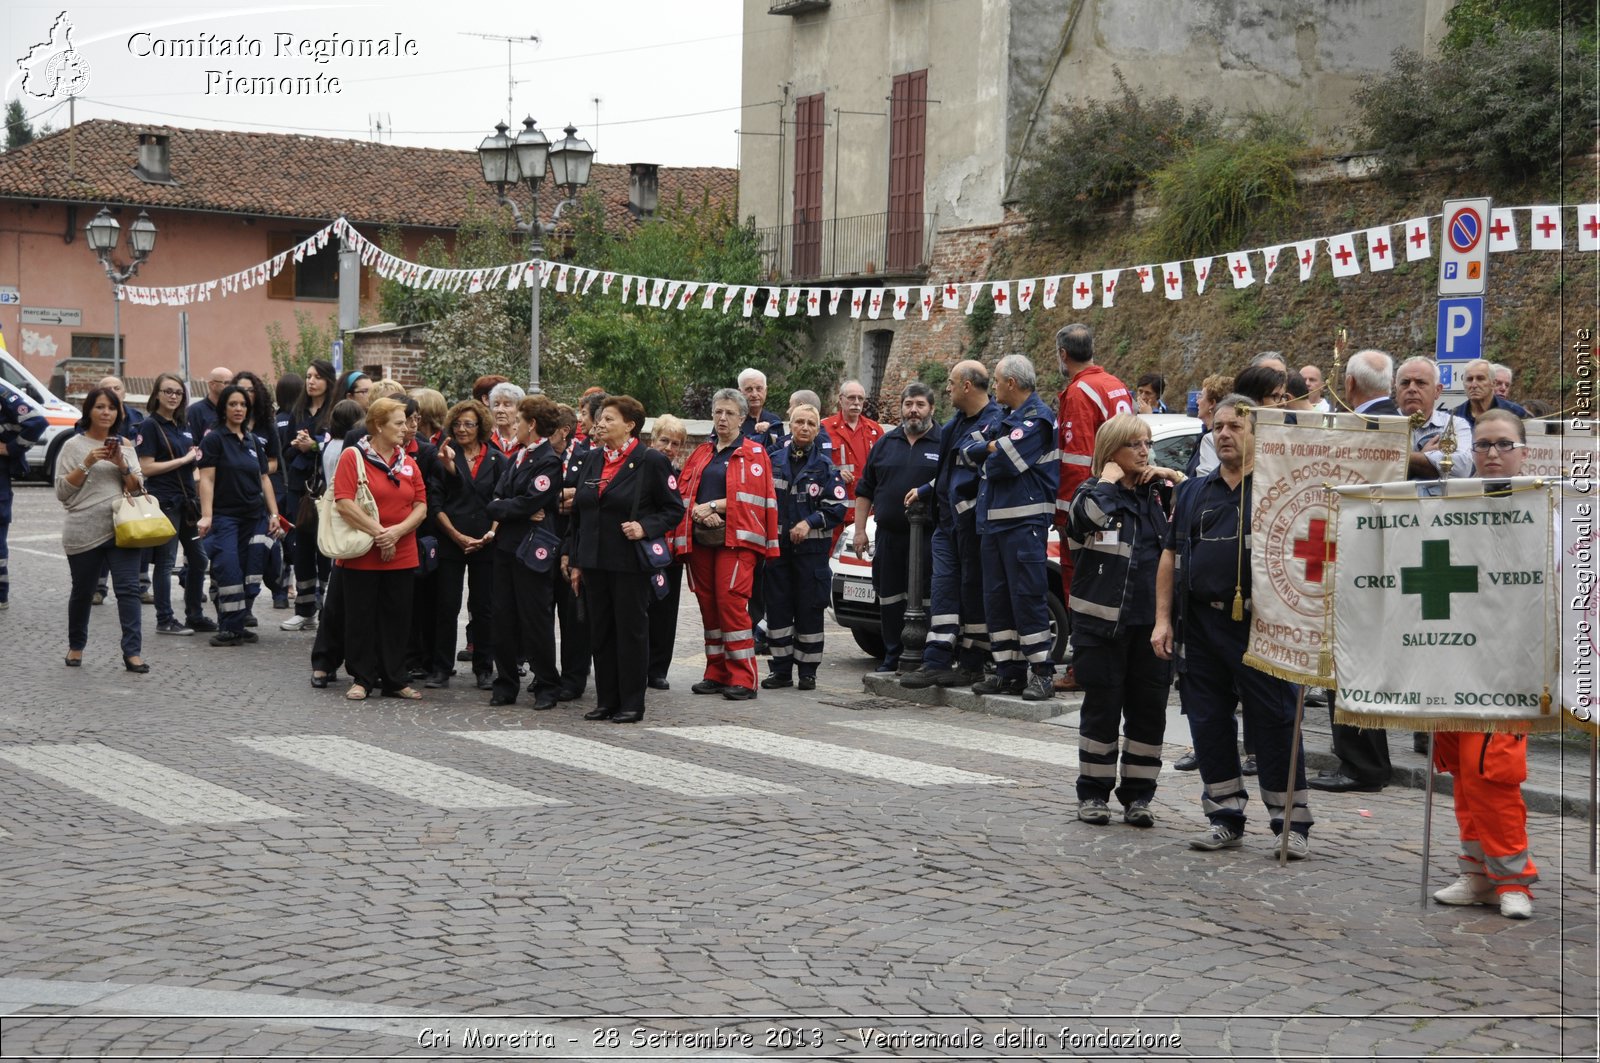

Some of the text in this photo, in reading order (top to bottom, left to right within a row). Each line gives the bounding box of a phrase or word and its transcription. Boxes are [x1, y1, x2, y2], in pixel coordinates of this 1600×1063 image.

[1446, 266, 1456, 278] P
[1446, 306, 1472, 352] P
[334, 344, 341, 369] P
[1262, 442, 1401, 462] CORPO VOLONTARI DEL SOCCORSO
[1252, 477, 1291, 533] CROCE
[1291, 462, 1342, 485] ROSSA
[1356, 510, 1534, 530] PULICA ASSISTENZA
[1269, 489, 1340, 607] CONVENZIONE DI GINEV
[1354, 571, 1544, 589] CRE VERDE
[855, 586, 866, 598] 228
[1310, 630, 1326, 646] D
[1402, 633, 1477, 647] SALUZZO
[1254, 636, 1310, 667] COMITATO
[1340, 688, 1421, 705] VOLONTARI
[1426, 696, 1448, 706] DEL
